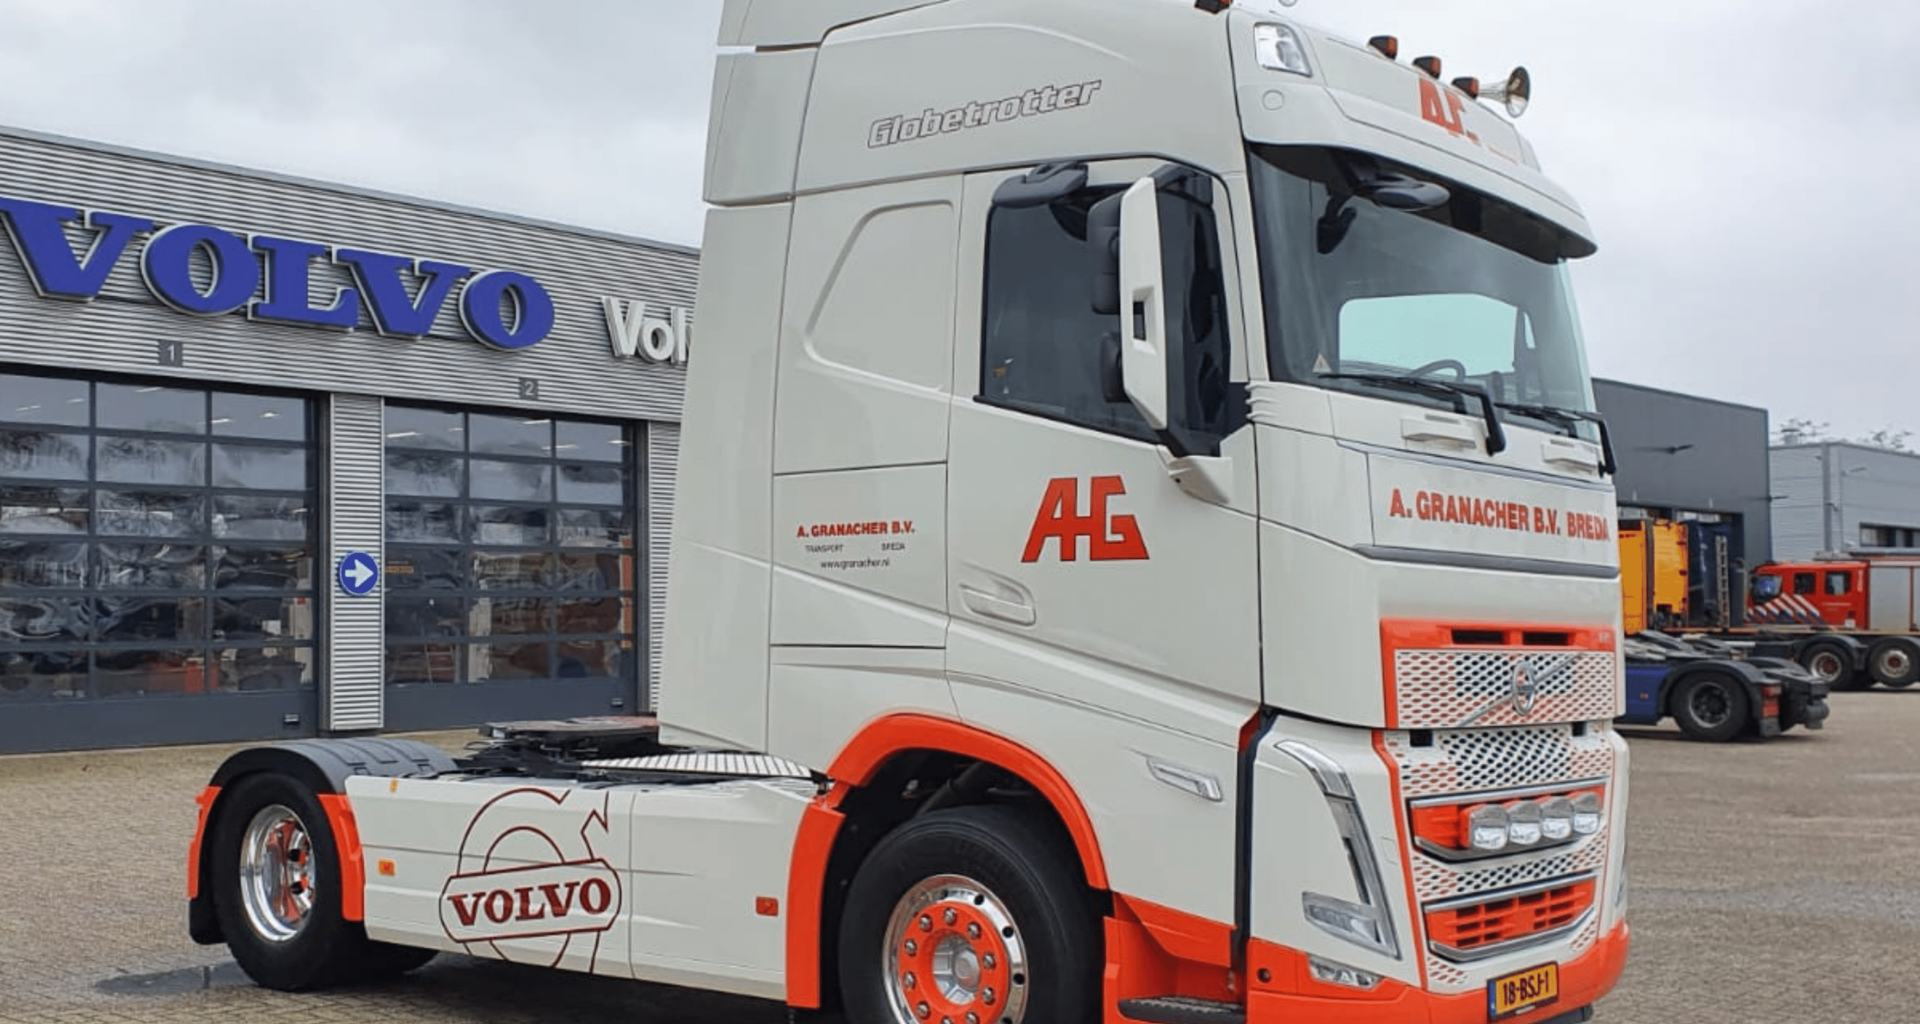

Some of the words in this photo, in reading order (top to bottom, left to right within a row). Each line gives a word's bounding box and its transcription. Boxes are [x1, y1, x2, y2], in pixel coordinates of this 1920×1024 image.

[867, 79, 1102, 148] Globetrotter
[0, 198, 556, 351] VOLVO
[601, 295, 692, 364] Vol
[166, 343, 175, 362] 1
[525, 381, 534, 396] 2
[797, 525, 809, 538] A.
[811, 521, 888, 537] GRANACHER
[891, 520, 916, 534] B.V.
[1389, 488, 1412, 518] A.
[1415, 490, 1530, 532] GRANACHER
[1532, 506, 1561, 535] B.V.
[1566, 511, 1610, 541] BREDA
[804, 544, 844, 553] TRANSPORT
[820, 556, 891, 570] www.granacher.nl
[448, 877, 611, 926] VOLVO
[1503, 970, 1549, 1006] 18-BSJ-1
